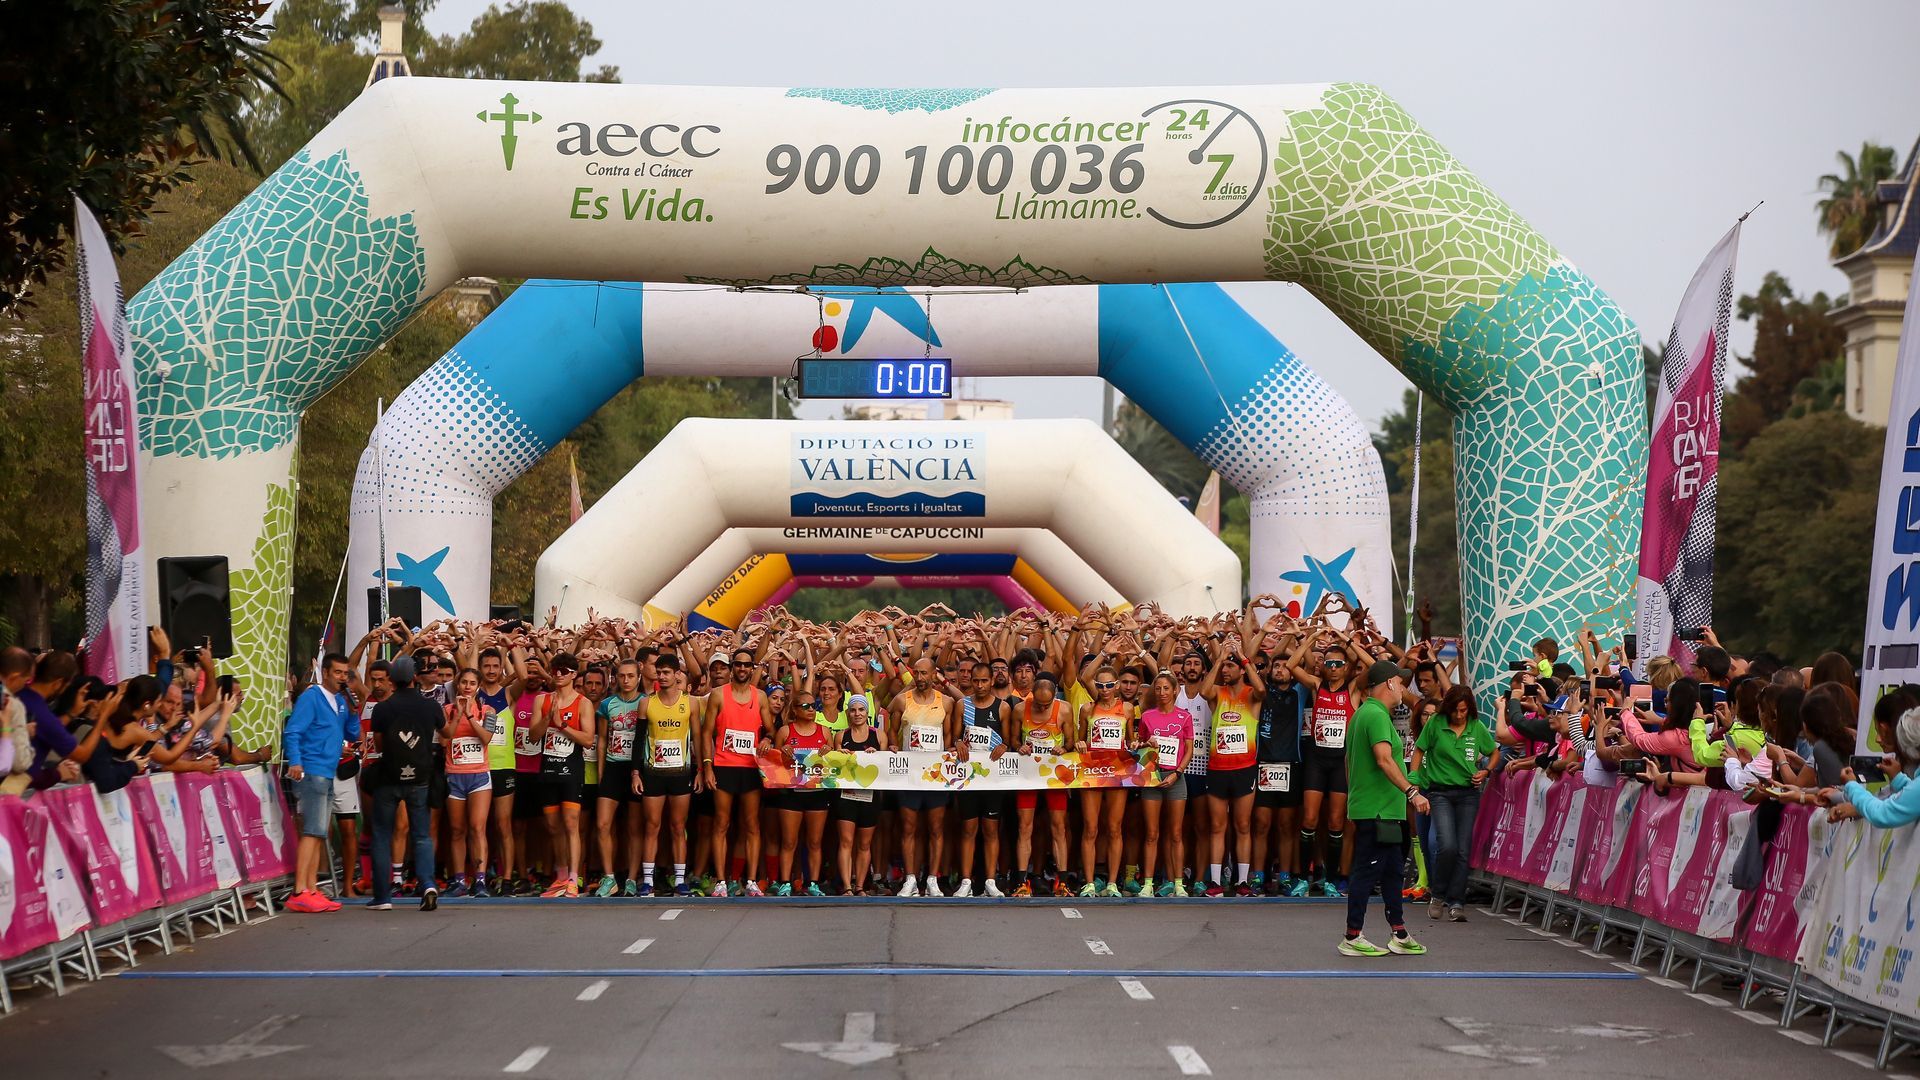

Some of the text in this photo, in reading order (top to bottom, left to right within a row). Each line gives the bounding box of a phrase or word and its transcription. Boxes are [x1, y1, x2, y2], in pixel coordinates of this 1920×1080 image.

[1166, 109, 1210, 131] 24
[962, 116, 1150, 143] infocáncer
[556, 122, 721, 158] aecc
[1165, 131, 1193, 140] horas
[586, 162, 693, 178] Contra el Cáncer
[765, 144, 1144, 195] 900 100 036
[1204, 154, 1248, 195] 7 días
[570, 187, 714, 222] Es Vida.
[995, 191, 1142, 220] Llámame.
[876, 363, 946, 394] 0:00
[800, 437, 974, 449] DIPUTACIÓ DE
[798, 453, 977, 481] VALÈNCIA
[813, 502, 962, 514] Joventut, Esports i Igualtat
[783, 527, 873, 539] GERMAINE
[890, 527, 984, 539] CAPUCCINI
[706, 553, 768, 608] ARROZ DACS
[658, 718, 681, 728] teika
[1101, 728, 1120, 738] 1253
[1324, 727, 1343, 737] 2187
[735, 738, 751, 749] 1130
[921, 733, 938, 743] 1221
[970, 733, 989, 744] 2206
[1226, 733, 1245, 743] 2601
[462, 743, 482, 753] 1335
[662, 746, 681, 757] 2022
[889, 757, 909, 768] RUN
[999, 758, 1019, 769] RUN
[804, 766, 837, 776] aecc
[945, 764, 957, 775] YO
[1083, 765, 1115, 776] aecc
[1268, 771, 1287, 781] 2021
